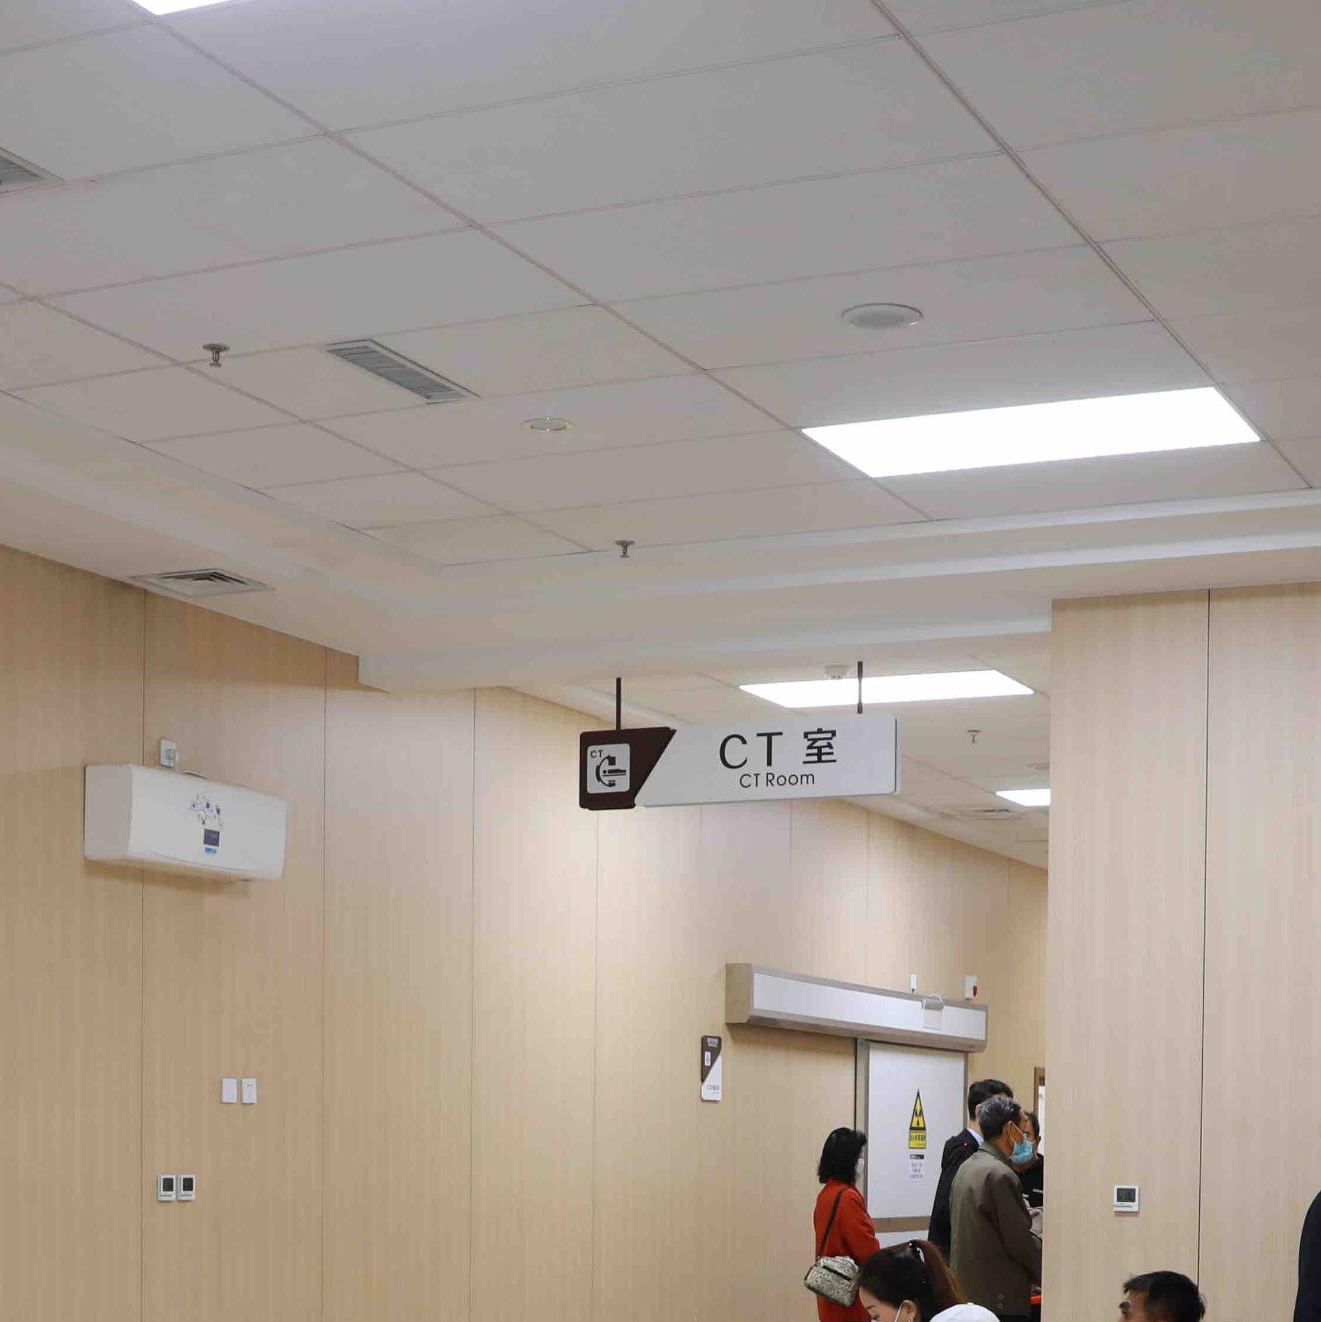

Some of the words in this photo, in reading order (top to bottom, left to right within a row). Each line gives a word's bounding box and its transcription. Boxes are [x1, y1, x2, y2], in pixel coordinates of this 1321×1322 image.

[719, 731, 784, 769] CT
[739, 772, 761, 788] CT
[765, 771, 815, 787] Room
